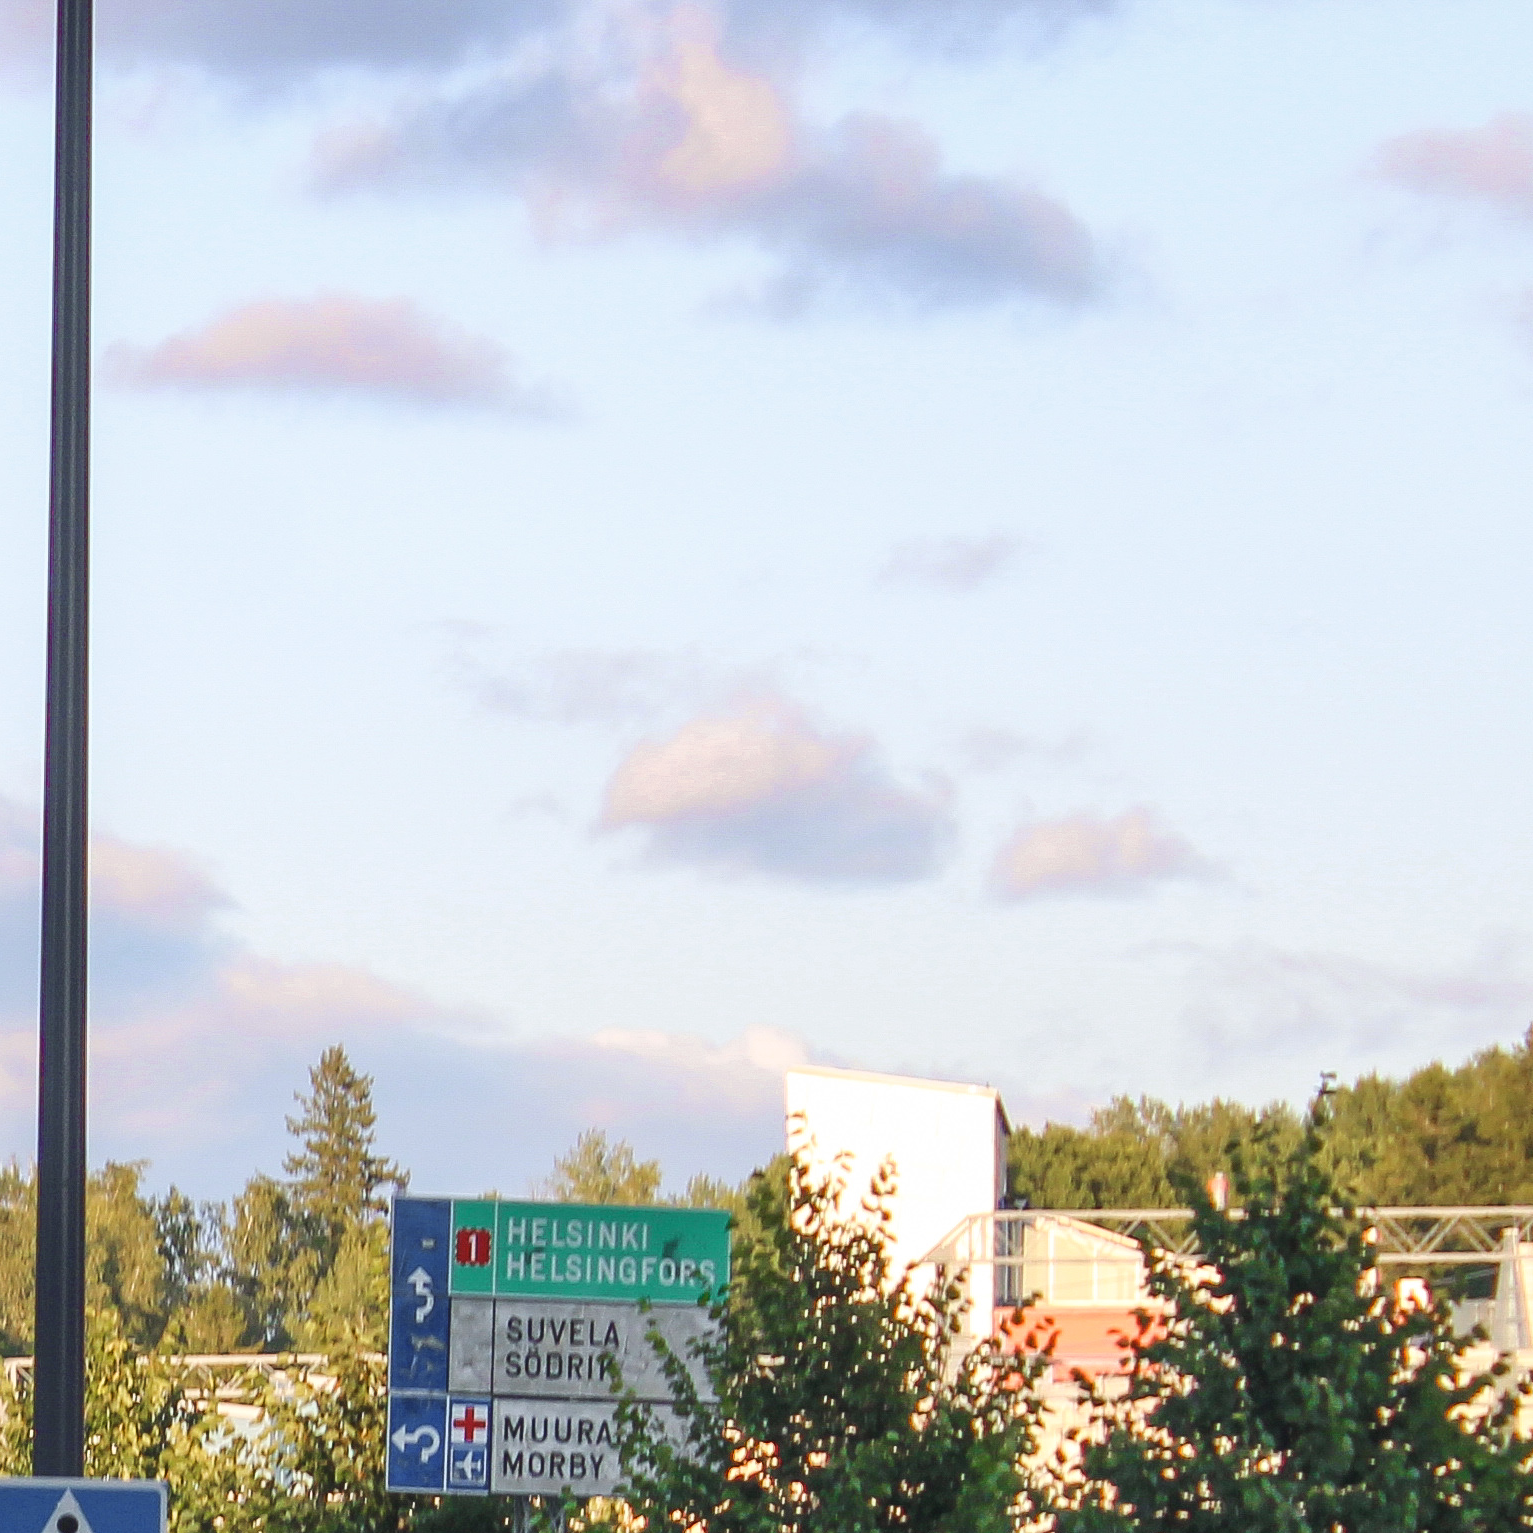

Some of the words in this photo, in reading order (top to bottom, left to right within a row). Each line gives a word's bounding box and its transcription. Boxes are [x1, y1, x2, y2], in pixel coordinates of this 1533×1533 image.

[506, 1216, 651, 1252] HELSINKI
[505, 1250, 716, 1287] HELSINGFORS
[507, 1316, 620, 1348] SUVELA
[503, 1450, 604, 1480] MORBY
